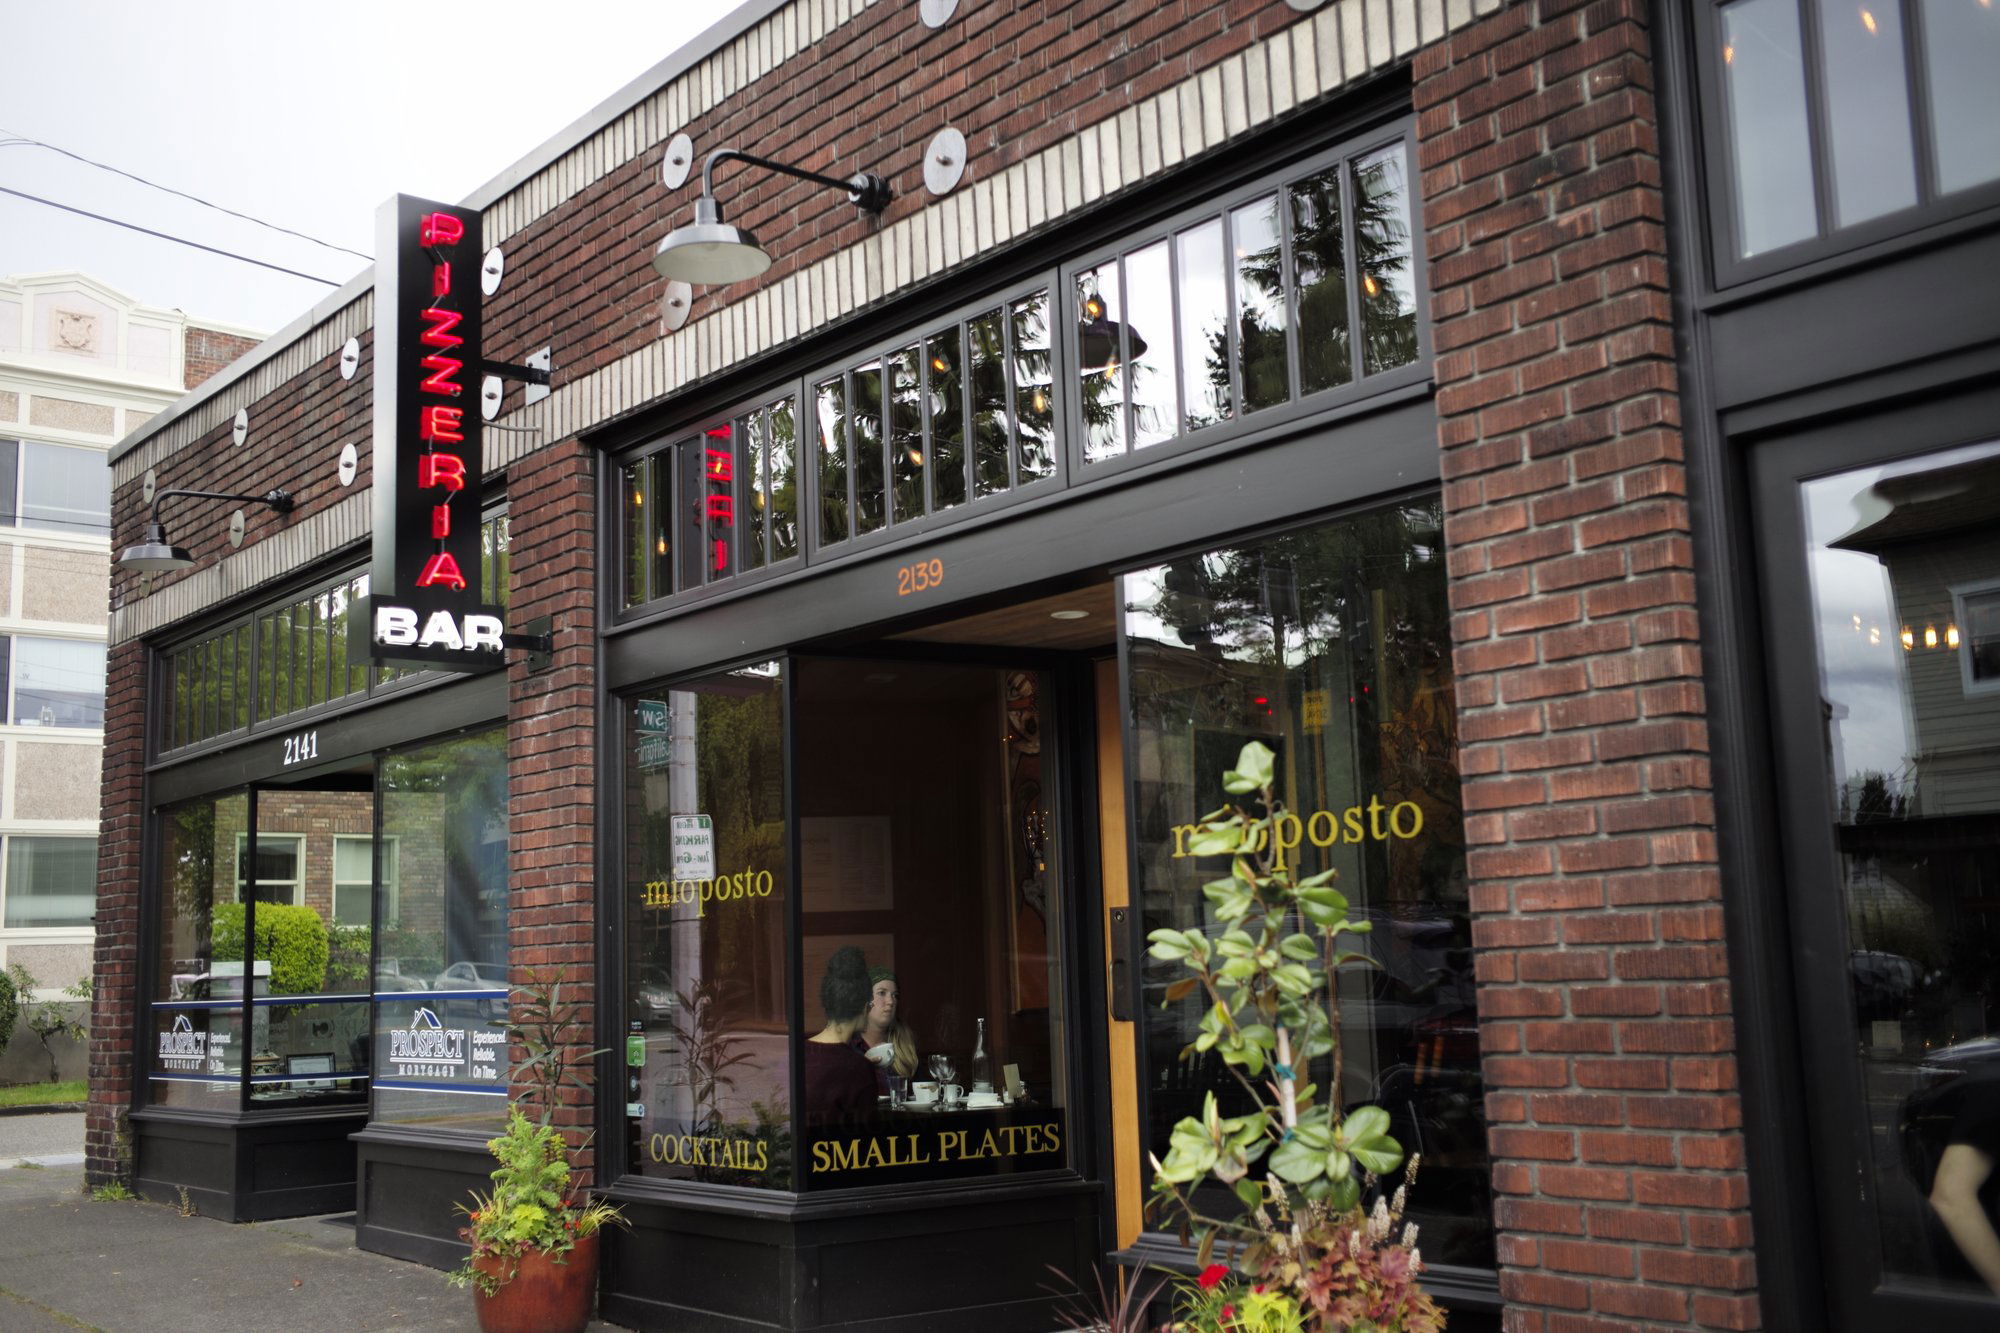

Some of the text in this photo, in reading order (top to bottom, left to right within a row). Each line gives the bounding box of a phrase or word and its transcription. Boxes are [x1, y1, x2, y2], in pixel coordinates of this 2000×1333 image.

[415, 212, 466, 590] PIZZERIA
[898, 558, 943, 596] 2139
[374, 606, 503, 653] BAR
[283, 730, 318, 766] 2141
[645, 864, 773, 918] mioposto
[159, 1032, 206, 1055] PROSPECT
[390, 1030, 465, 1058] PROSPECT
[399, 1064, 455, 1077] MORTGAGE
[473, 1065, 481, 1079] On
[650, 1132, 768, 1172] COCKTAILS
[812, 1122, 1061, 1174] SMALL PLATES
